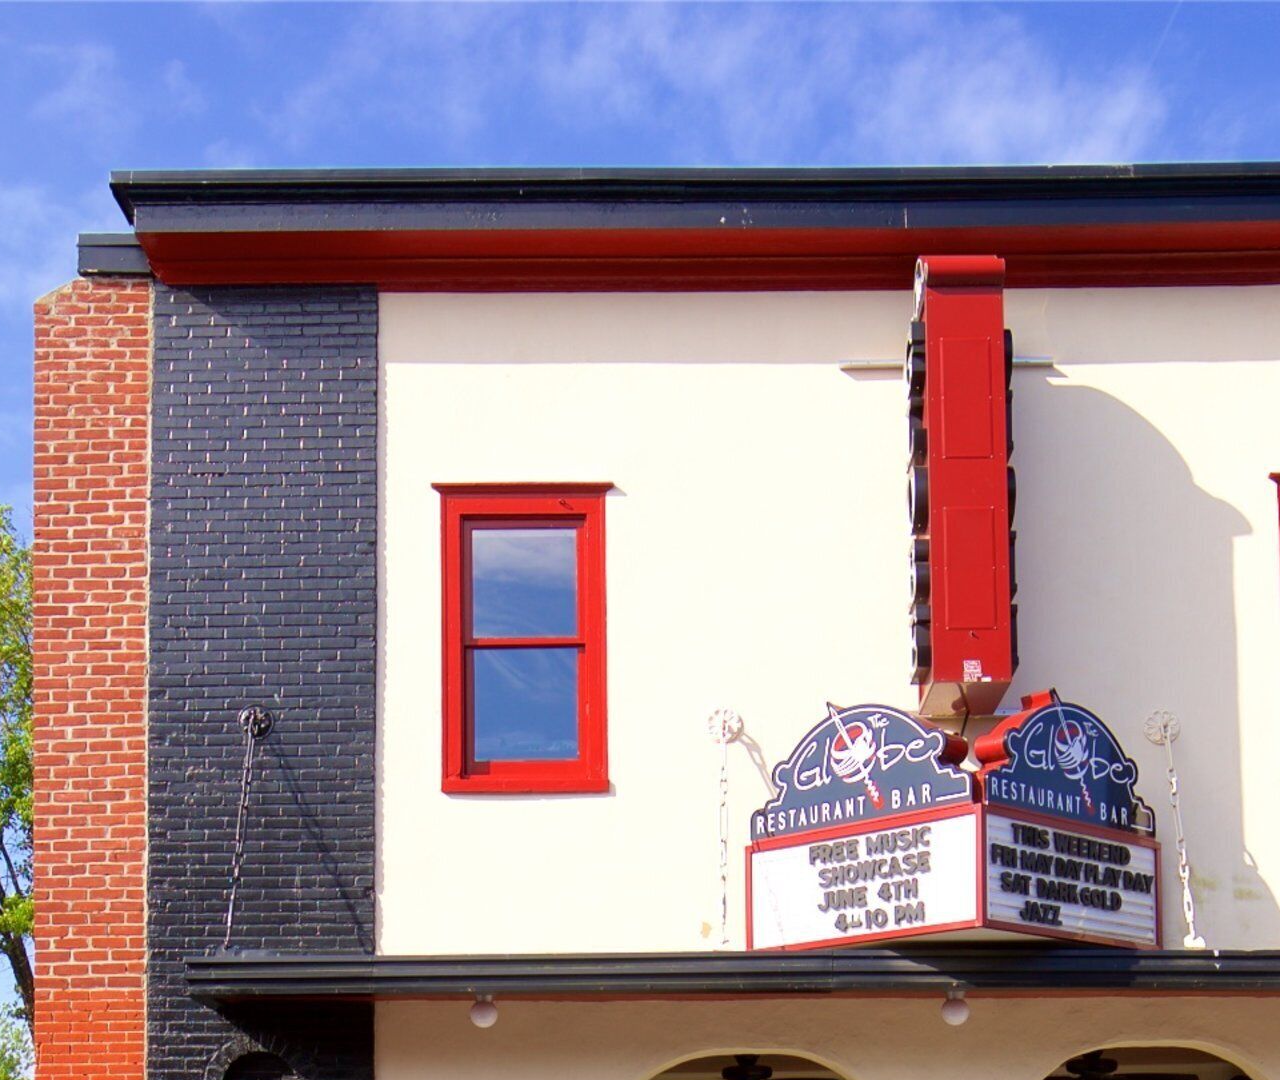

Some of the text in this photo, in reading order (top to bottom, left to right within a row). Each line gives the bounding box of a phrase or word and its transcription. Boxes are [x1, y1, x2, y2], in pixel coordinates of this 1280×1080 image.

[867, 713, 890, 729] The
[756, 784, 932, 835] RESTAURANT BAR
[991, 776, 1128, 826] RESTAURANT BAR
[809, 826, 932, 865] FREE MUSIC
[1011, 822, 1131, 866] THIS WEEKEND
[818, 851, 931, 888] SHOWCASE
[991, 843, 1154, 894] FRI MAY DAY PLAY DAY
[818, 878, 918, 912] JUNE 4TH
[1001, 871, 1122, 911] SAT DARK GOLD
[894, 901, 925, 926] PM
[1020, 900, 1063, 926] JAZZ
